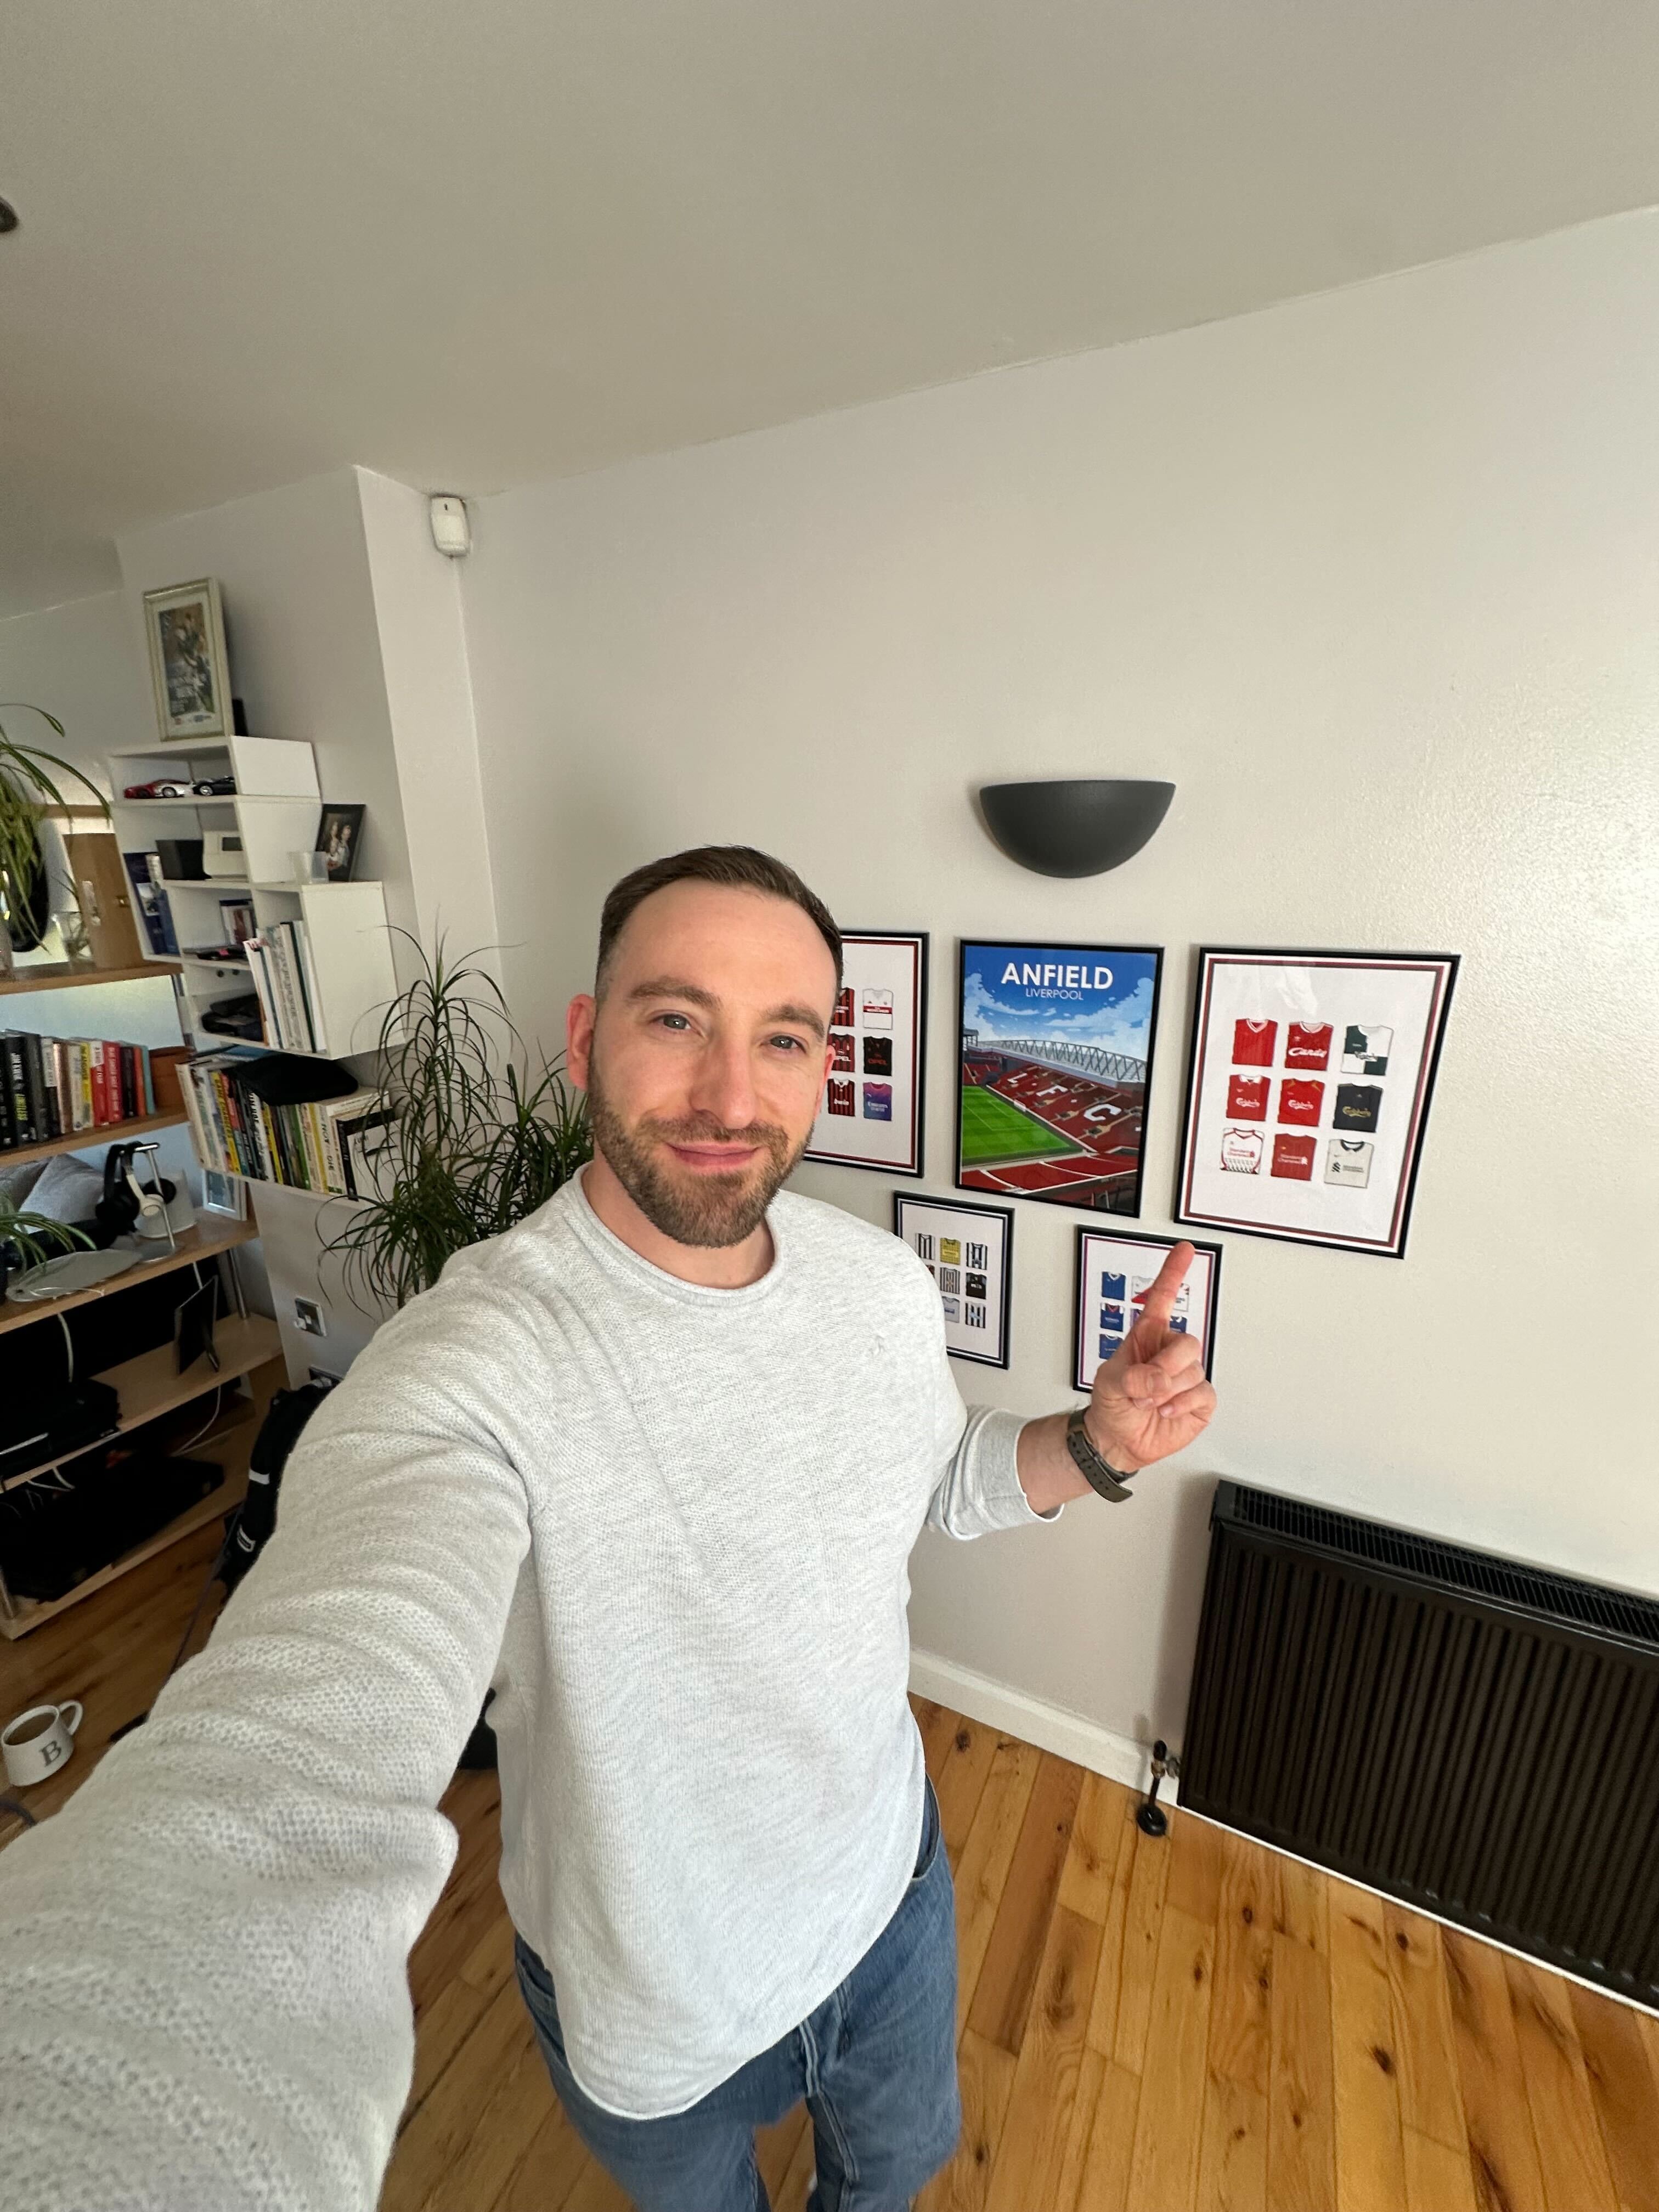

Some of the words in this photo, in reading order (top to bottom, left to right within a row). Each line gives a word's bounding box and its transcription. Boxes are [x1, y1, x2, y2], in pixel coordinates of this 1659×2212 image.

[1001, 962, 1113, 990] ANFIELD
[1025, 988, 1084, 1001] LIVERPOOL
[321, 1124, 330, 1144] NOT
[40, 1740, 62, 1767] B
